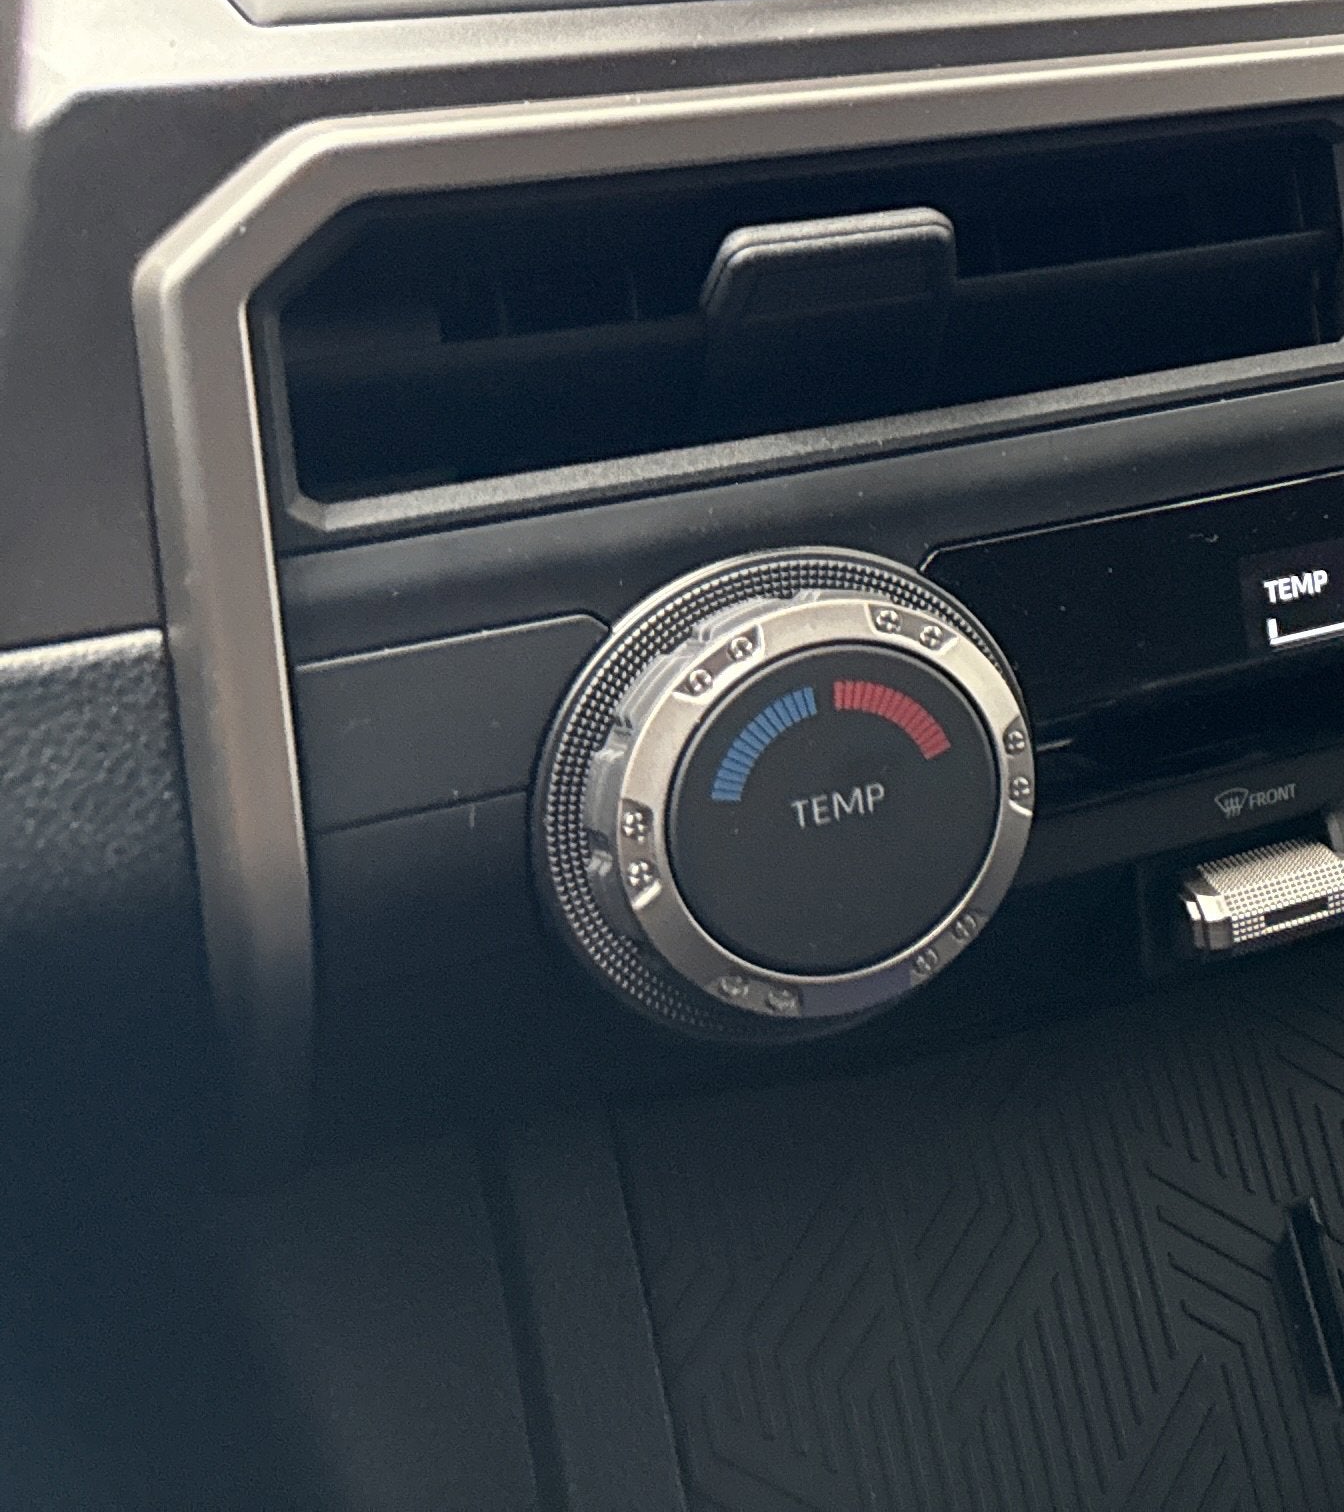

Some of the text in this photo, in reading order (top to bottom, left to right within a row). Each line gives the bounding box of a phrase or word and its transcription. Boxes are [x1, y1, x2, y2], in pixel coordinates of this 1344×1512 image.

[1263, 569, 1330, 605] TEMP
[790, 782, 886, 829] TEMP
[1248, 783, 1297, 811] FRONT
